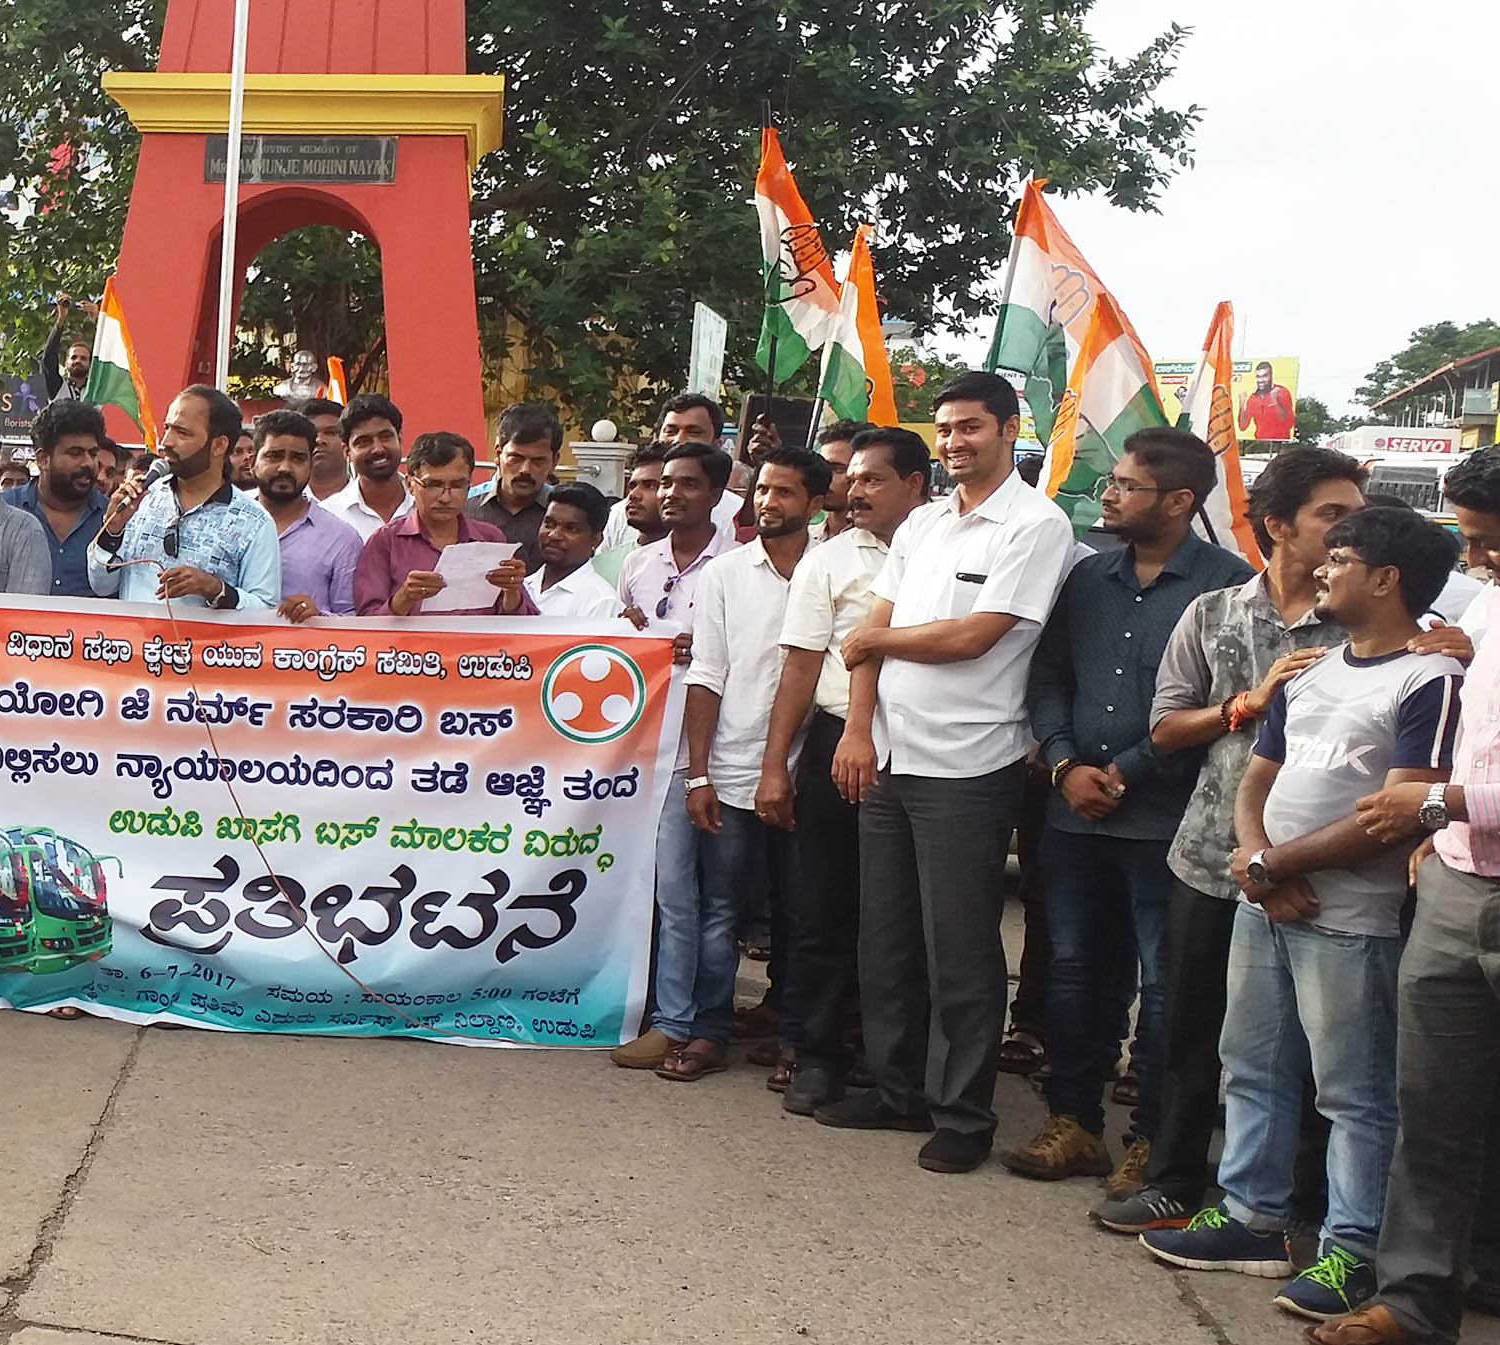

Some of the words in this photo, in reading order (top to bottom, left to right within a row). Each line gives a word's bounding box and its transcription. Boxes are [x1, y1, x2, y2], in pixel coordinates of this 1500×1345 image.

[299, 145, 340, 154] MEMORY
[302, 158, 347, 175] MOHINI
[349, 159, 392, 175] NAYAK
[1390, 438, 1445, 453] SERVO
[7, 630, 73, 661] ವಿಧಾನ
[83, 631, 132, 664] ಸಭಾ
[144, 636, 193, 676] ಕ್ಷೇತ್ರ
[202, 641, 263, 669] ಯುವ
[273, 645, 366, 681] ಕಾಂಗ್ರೆಸ್
[376, 648, 447, 679] ಸಮಿತಿ,
[458, 650, 532, 680] ಉಡುಪಿ
[121, 688, 150, 720] ಜೆ
[290, 697, 422, 733] ಸರಕಾರಿ
[440, 707, 512, 738] ಬಸ್
[116, 750, 393, 799] ನ್ಯಾಯಾಲಯದಿಂದ
[411, 761, 469, 795] ತಡೆ
[485, 765, 551, 818] ಆಜ್ಞೆ
[563, 766, 639, 801] ತಂದ
[109, 806, 203, 838] ಉಡುಪಿ
[215, 811, 301, 846] ಖಾಸಗಿ
[315, 816, 380, 850] ಬಸ್
[390, 817, 512, 854] ಮಾಲಕರ
[523, 824, 615, 873] ವಿರುದ್ಧ
[139, 854, 588, 965] ಪ್ರತಿಭಟನೆ
[266, 984, 333, 1004] ಸಮಯ
[470, 987, 512, 1001] 5:00
[532, 1017, 597, 1039] ಉಡುಪಿ
